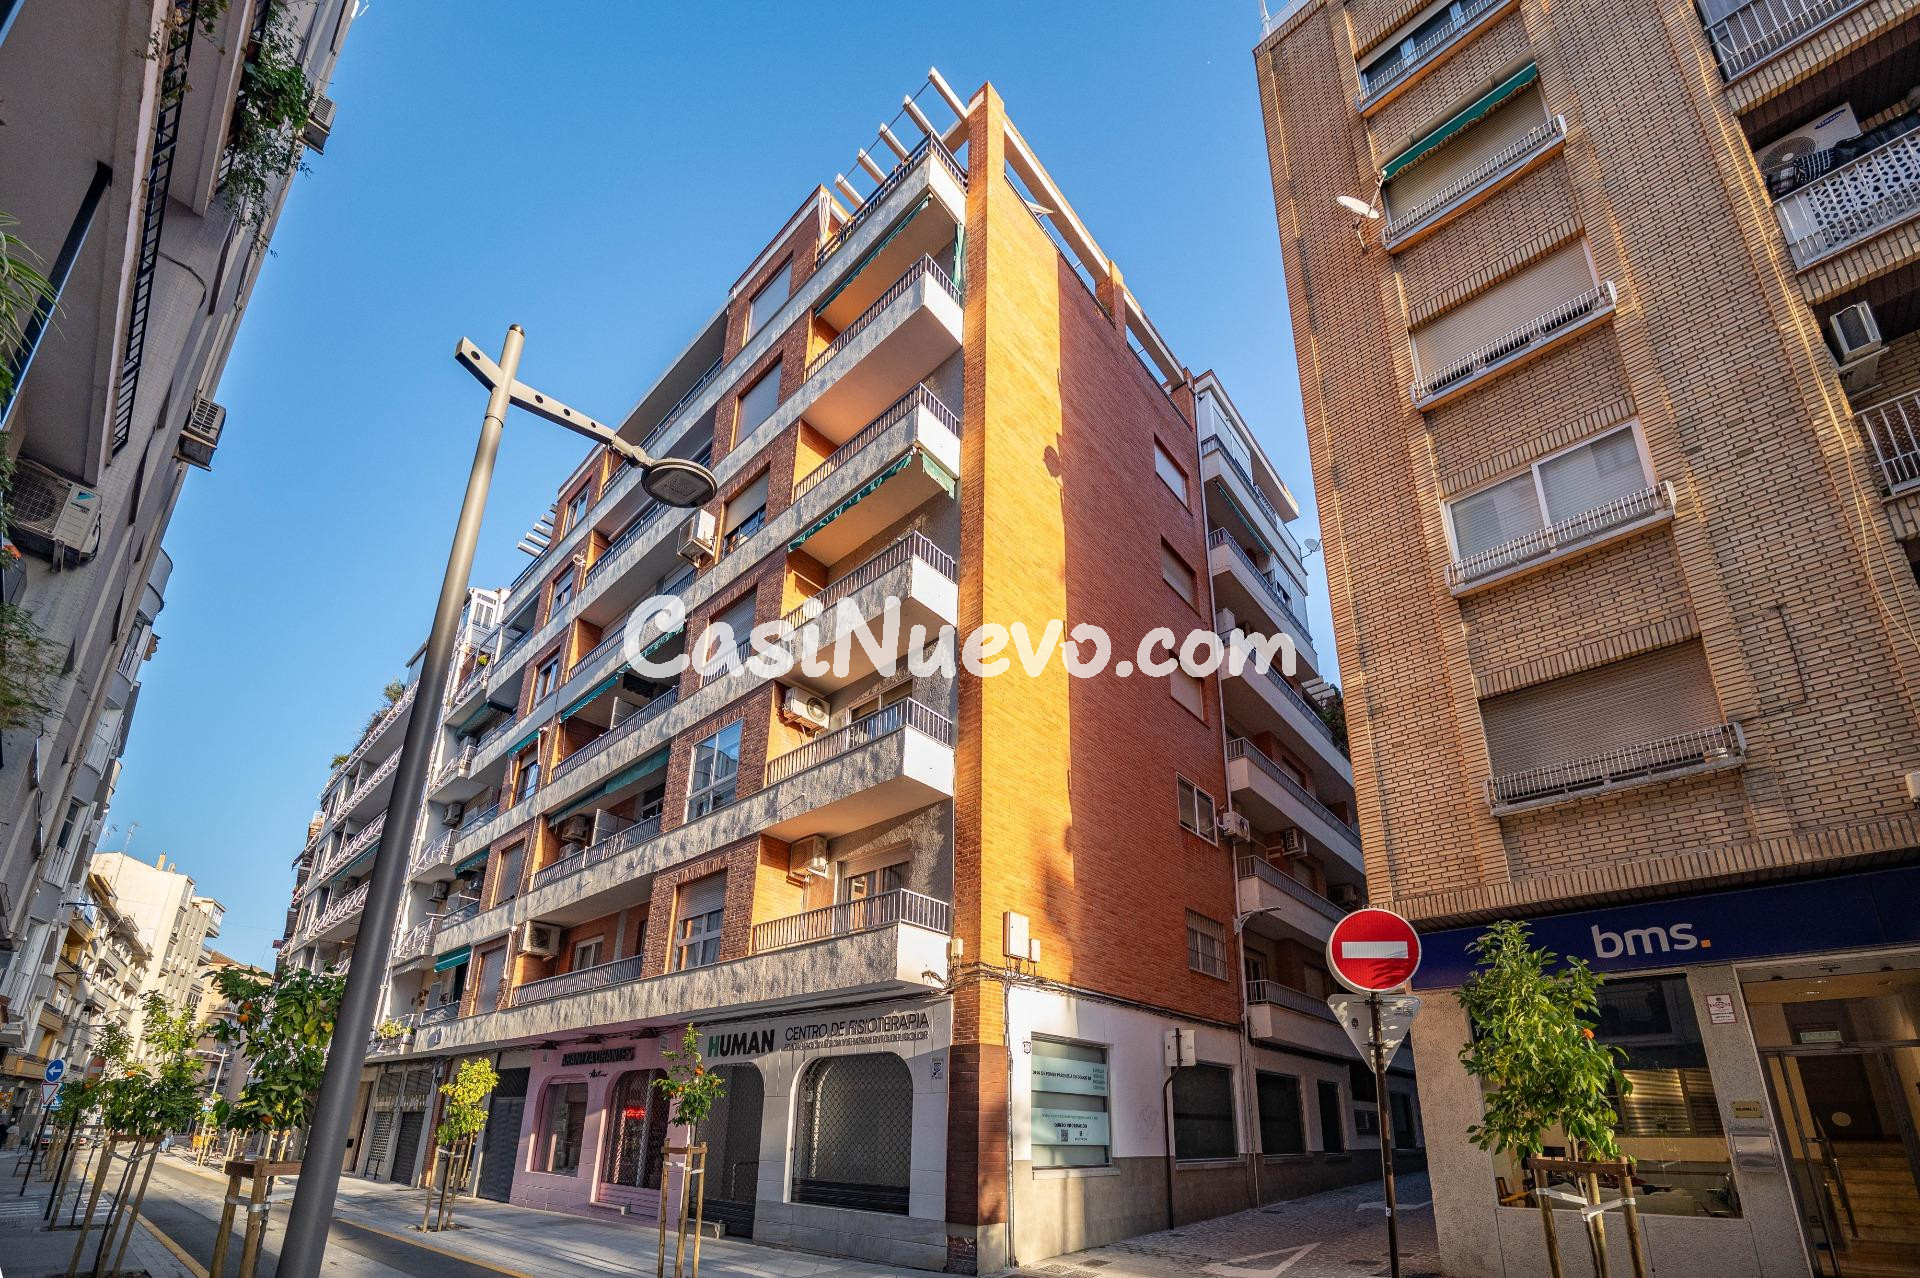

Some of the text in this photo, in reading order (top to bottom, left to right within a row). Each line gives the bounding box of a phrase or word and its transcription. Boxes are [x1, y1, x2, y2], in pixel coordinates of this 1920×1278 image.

[785, 1012, 929, 1041] CENTRO DE FISIOTERAPIA
[707, 1028, 775, 1057] HUMAN
